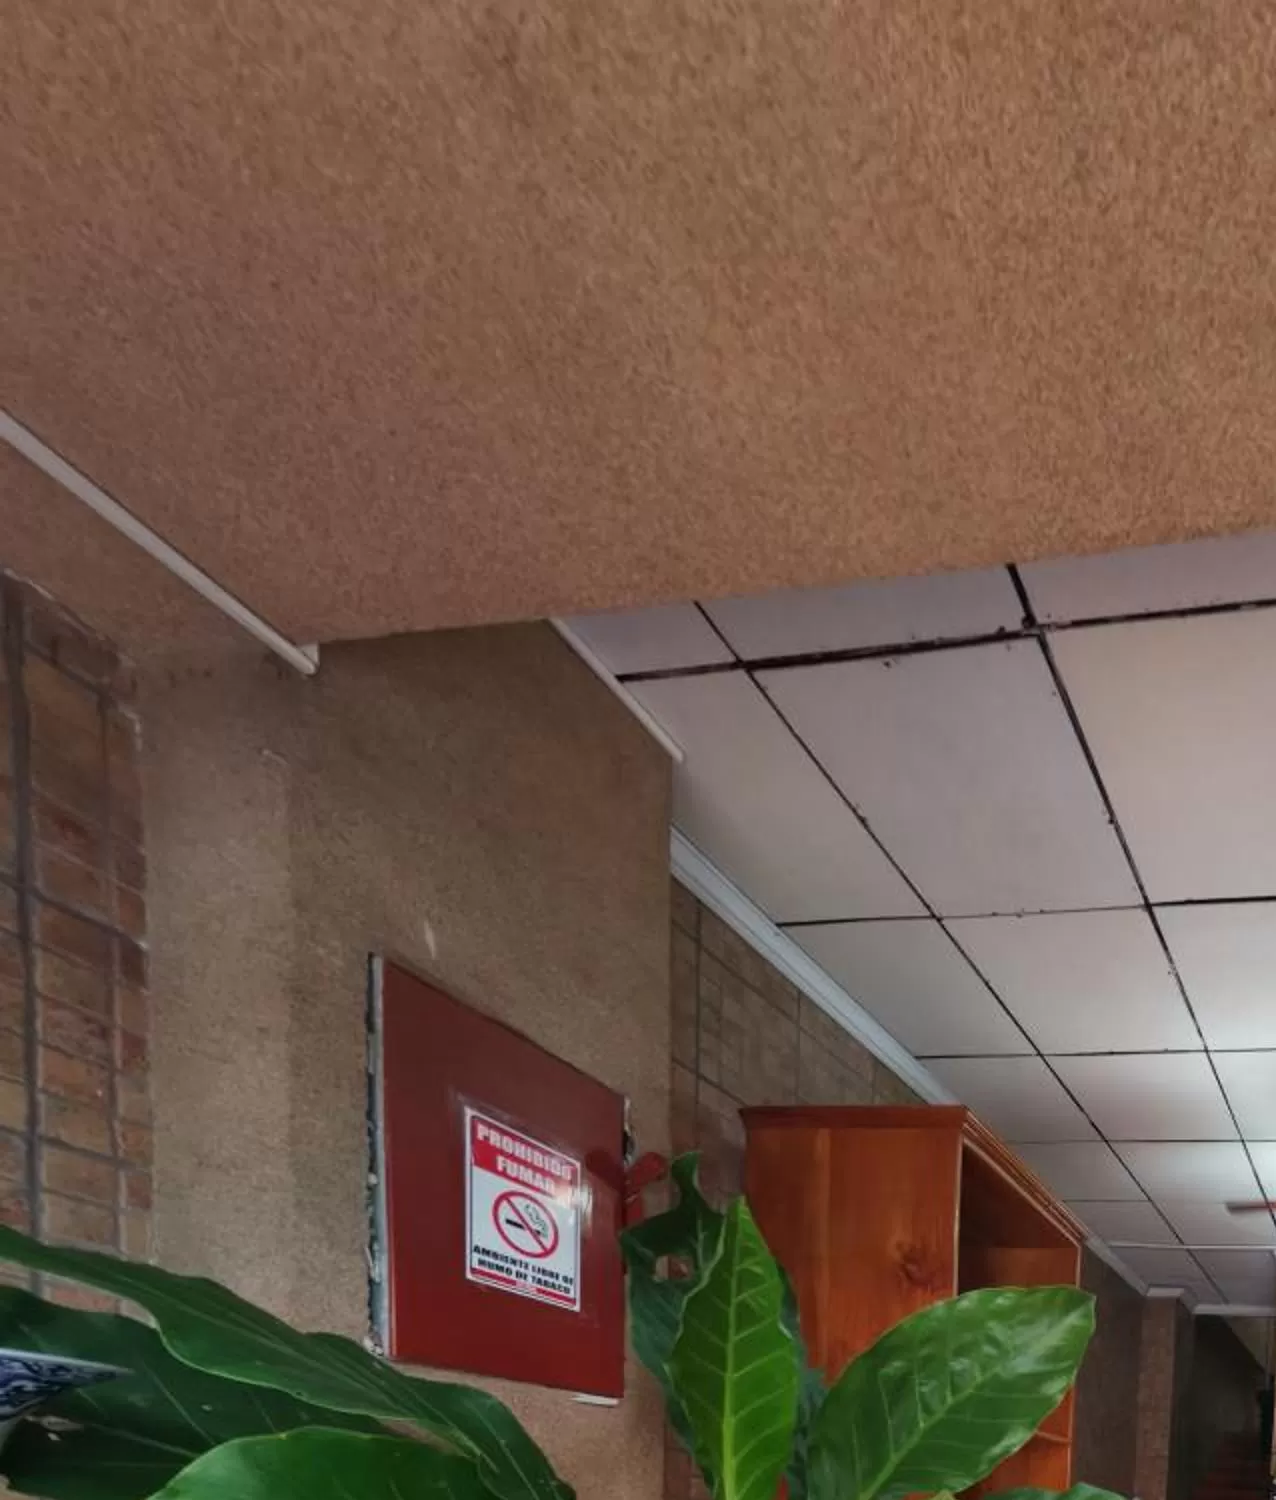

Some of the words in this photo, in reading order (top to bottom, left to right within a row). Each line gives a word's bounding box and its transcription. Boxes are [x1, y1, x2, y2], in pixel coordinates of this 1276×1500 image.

[477, 1123, 571, 1180] PROHIBIDO
[496, 1155, 555, 1195] FUMAR
[473, 1244, 529, 1270] AMBIENTE
[477, 1258, 513, 1276] HUMO
[531, 1275, 571, 1294] TABACO
